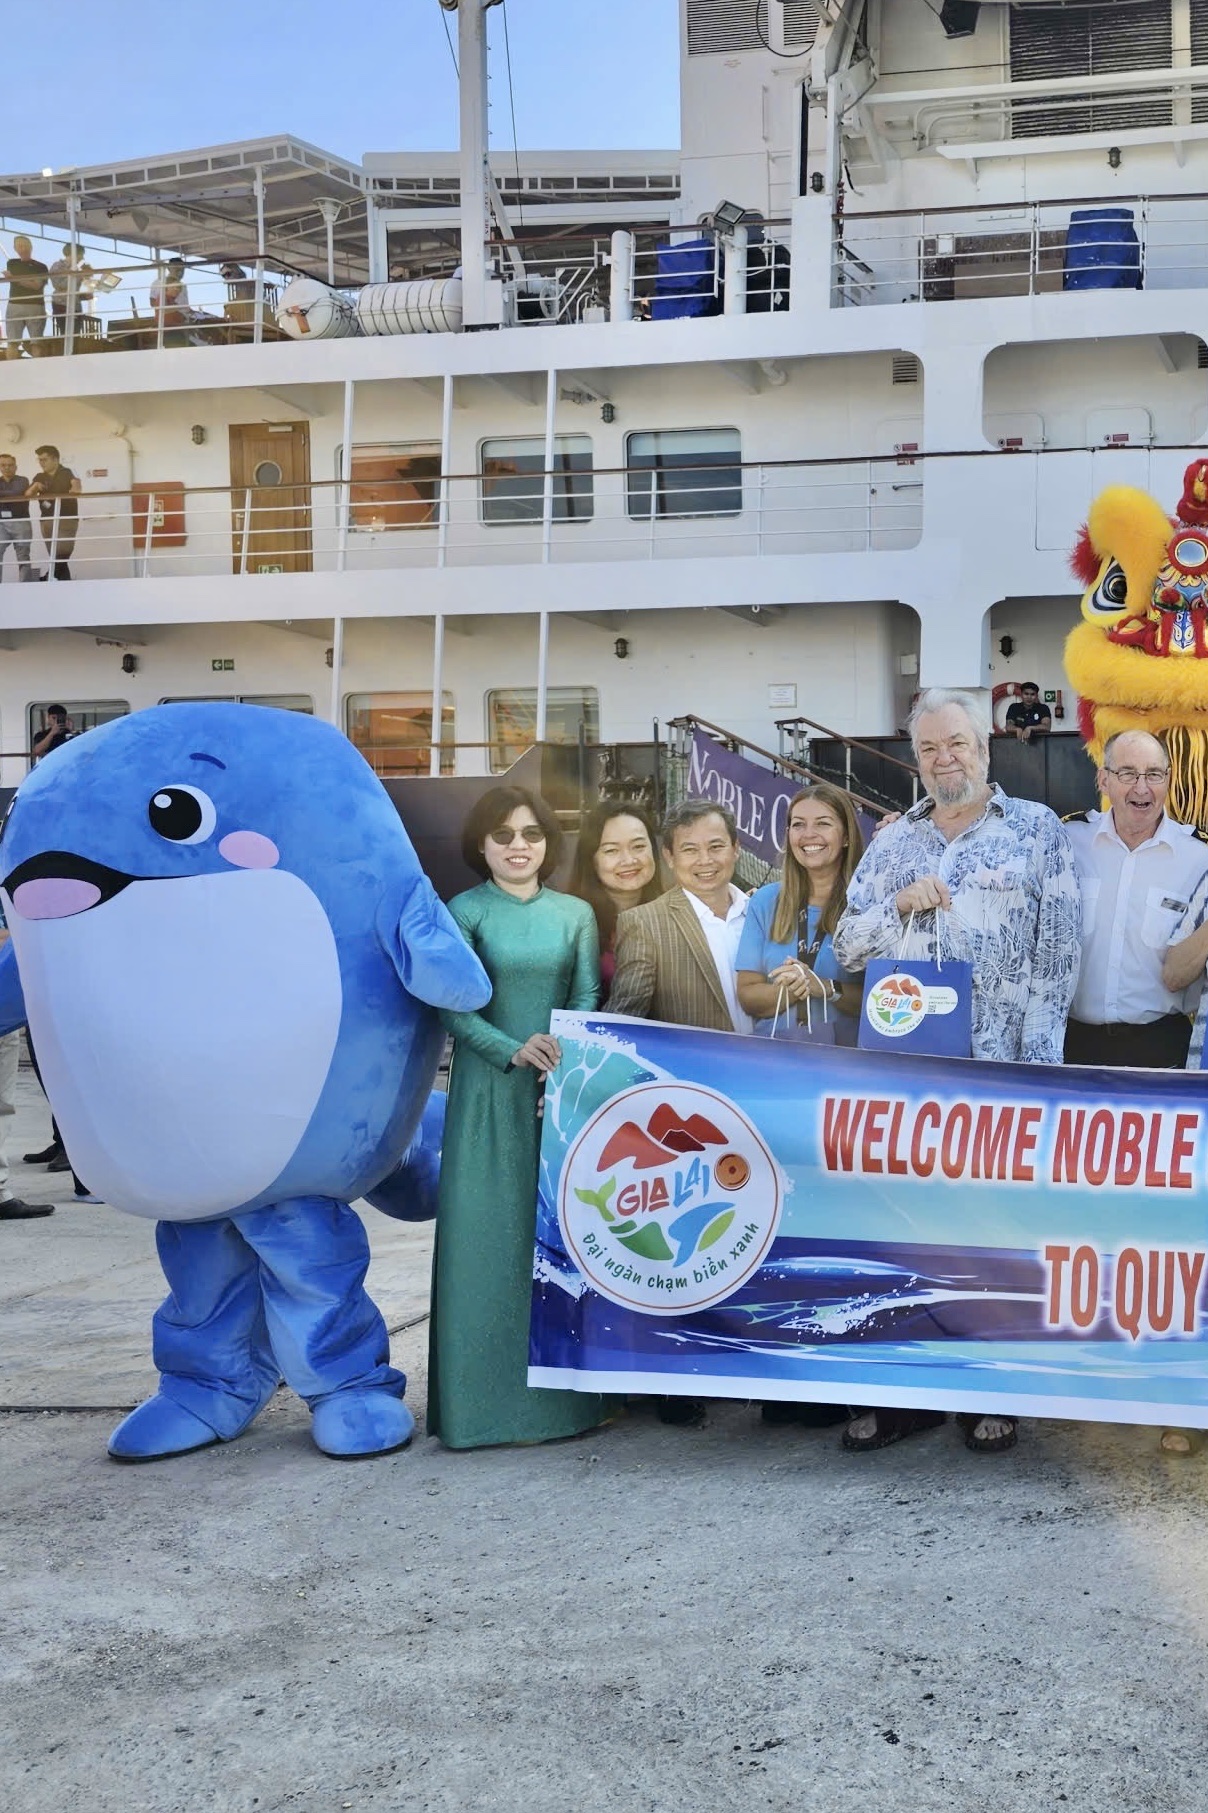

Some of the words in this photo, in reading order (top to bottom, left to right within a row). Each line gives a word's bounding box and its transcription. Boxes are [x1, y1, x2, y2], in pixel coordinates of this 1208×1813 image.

[687, 740, 766, 842] NOBLE
[616, 1176, 670, 1216] GIA
[673, 1156, 710, 1208] LAI
[823, 1097, 1043, 1182] WELCOME
[1051, 1109, 1199, 1189] NOBLE
[582, 1231, 608, 1259] Đại
[603, 1257, 643, 1285] ngàn
[647, 1274, 688, 1293] chạm
[693, 1257, 729, 1284] biển
[729, 1222, 760, 1261] xanh
[1045, 1245, 1099, 1328] TO
[1115, 1247, 1206, 1341] QUY
